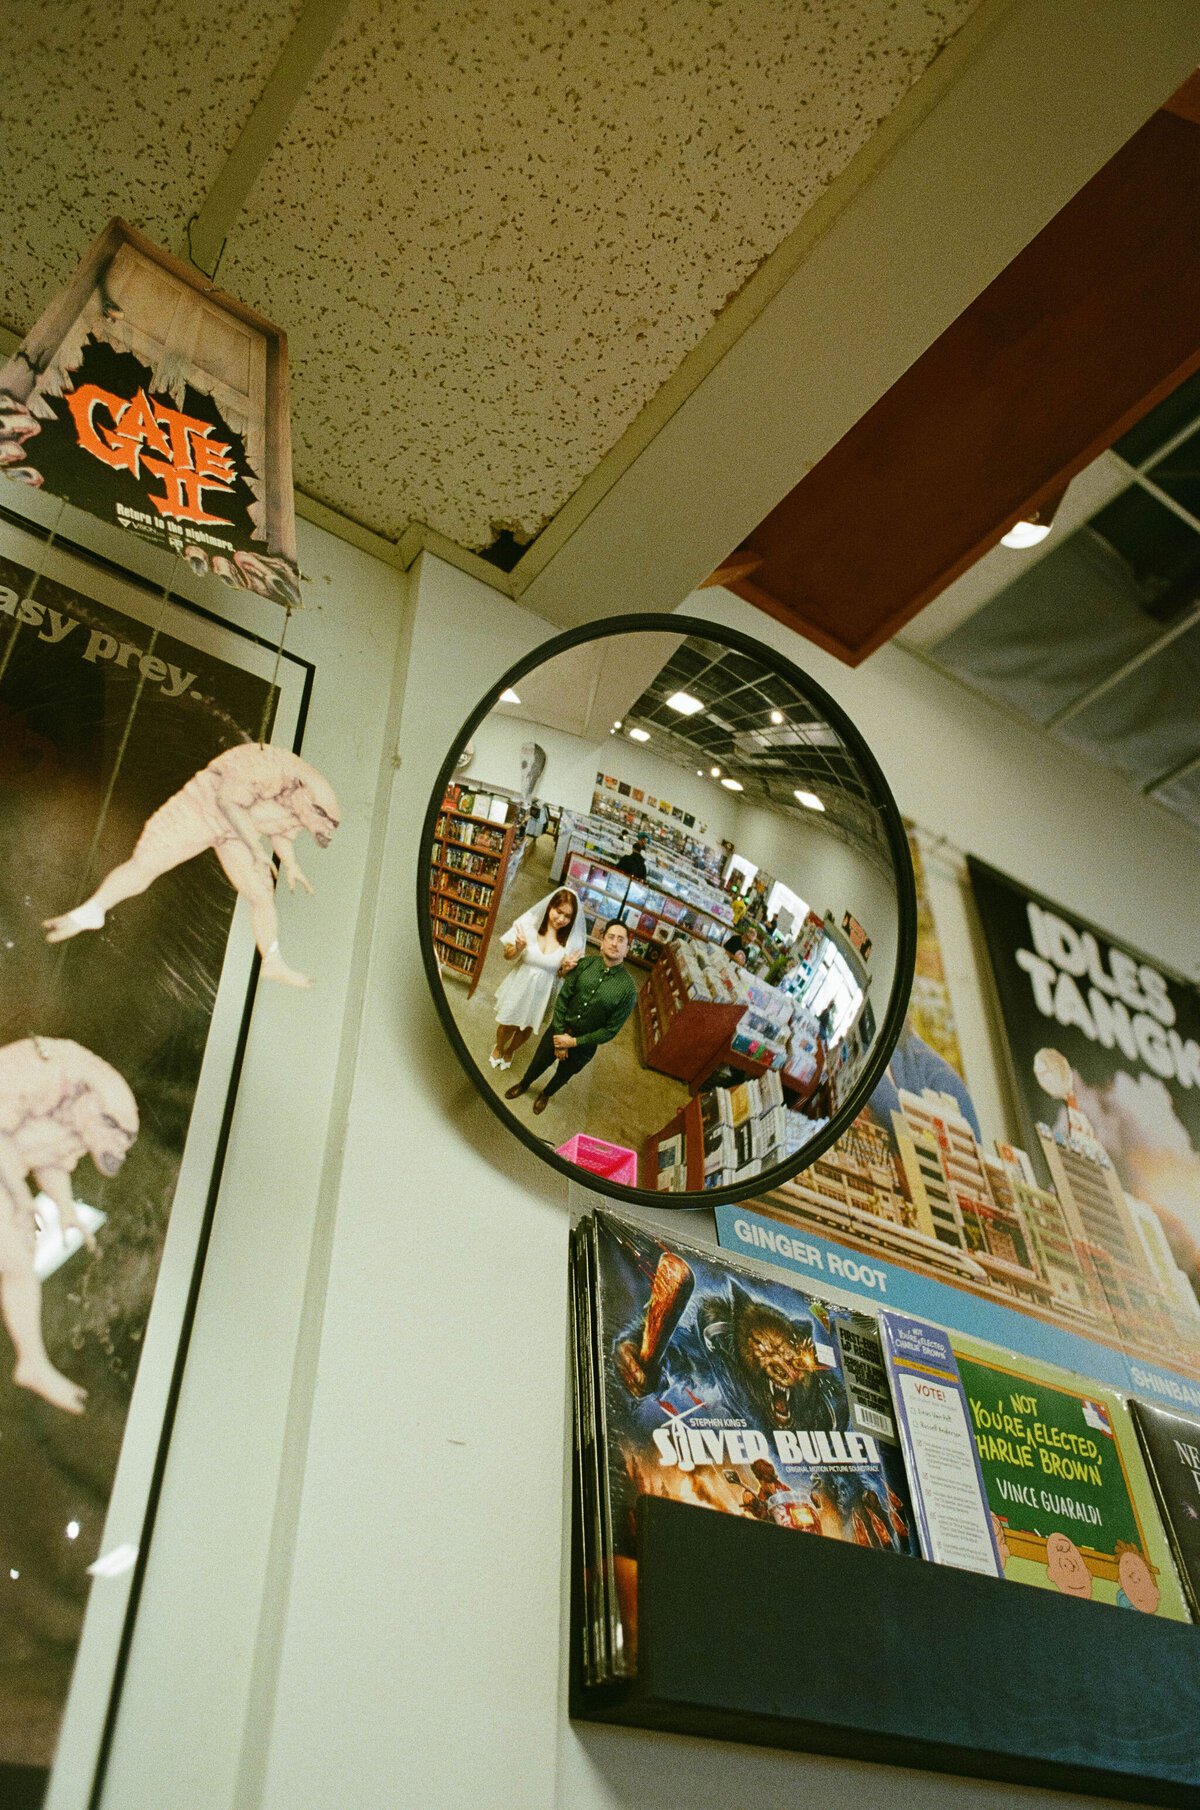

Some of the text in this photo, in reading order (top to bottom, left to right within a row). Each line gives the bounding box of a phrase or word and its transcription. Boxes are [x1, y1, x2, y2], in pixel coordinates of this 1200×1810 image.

[64, 384, 238, 482] GATE
[139, 453, 236, 527] II
[116, 503, 153, 525] Return
[154, 516, 165, 530] to
[167, 520, 184, 536] the
[185, 527, 236, 553] nightmare.
[82, 629, 203, 700] prey.
[1027, 901, 1176, 1027] IDLES
[734, 1219, 887, 1293] GINGER ROOT
[914, 1383, 947, 1402] VOTE!
[1010, 1393, 1037, 1417] NOT
[689, 1417, 723, 1428] STEPHEN
[773, 1430, 880, 1464] BULLET
[969, 1397, 1102, 1465] YOU'RE ELECTED,
[974, 1434, 1034, 1468] HARLIE
[1039, 1448, 1102, 1487] BROWN
[996, 1477, 1039, 1509] VINCE
[1040, 1490, 1102, 1526] GUARALDI
